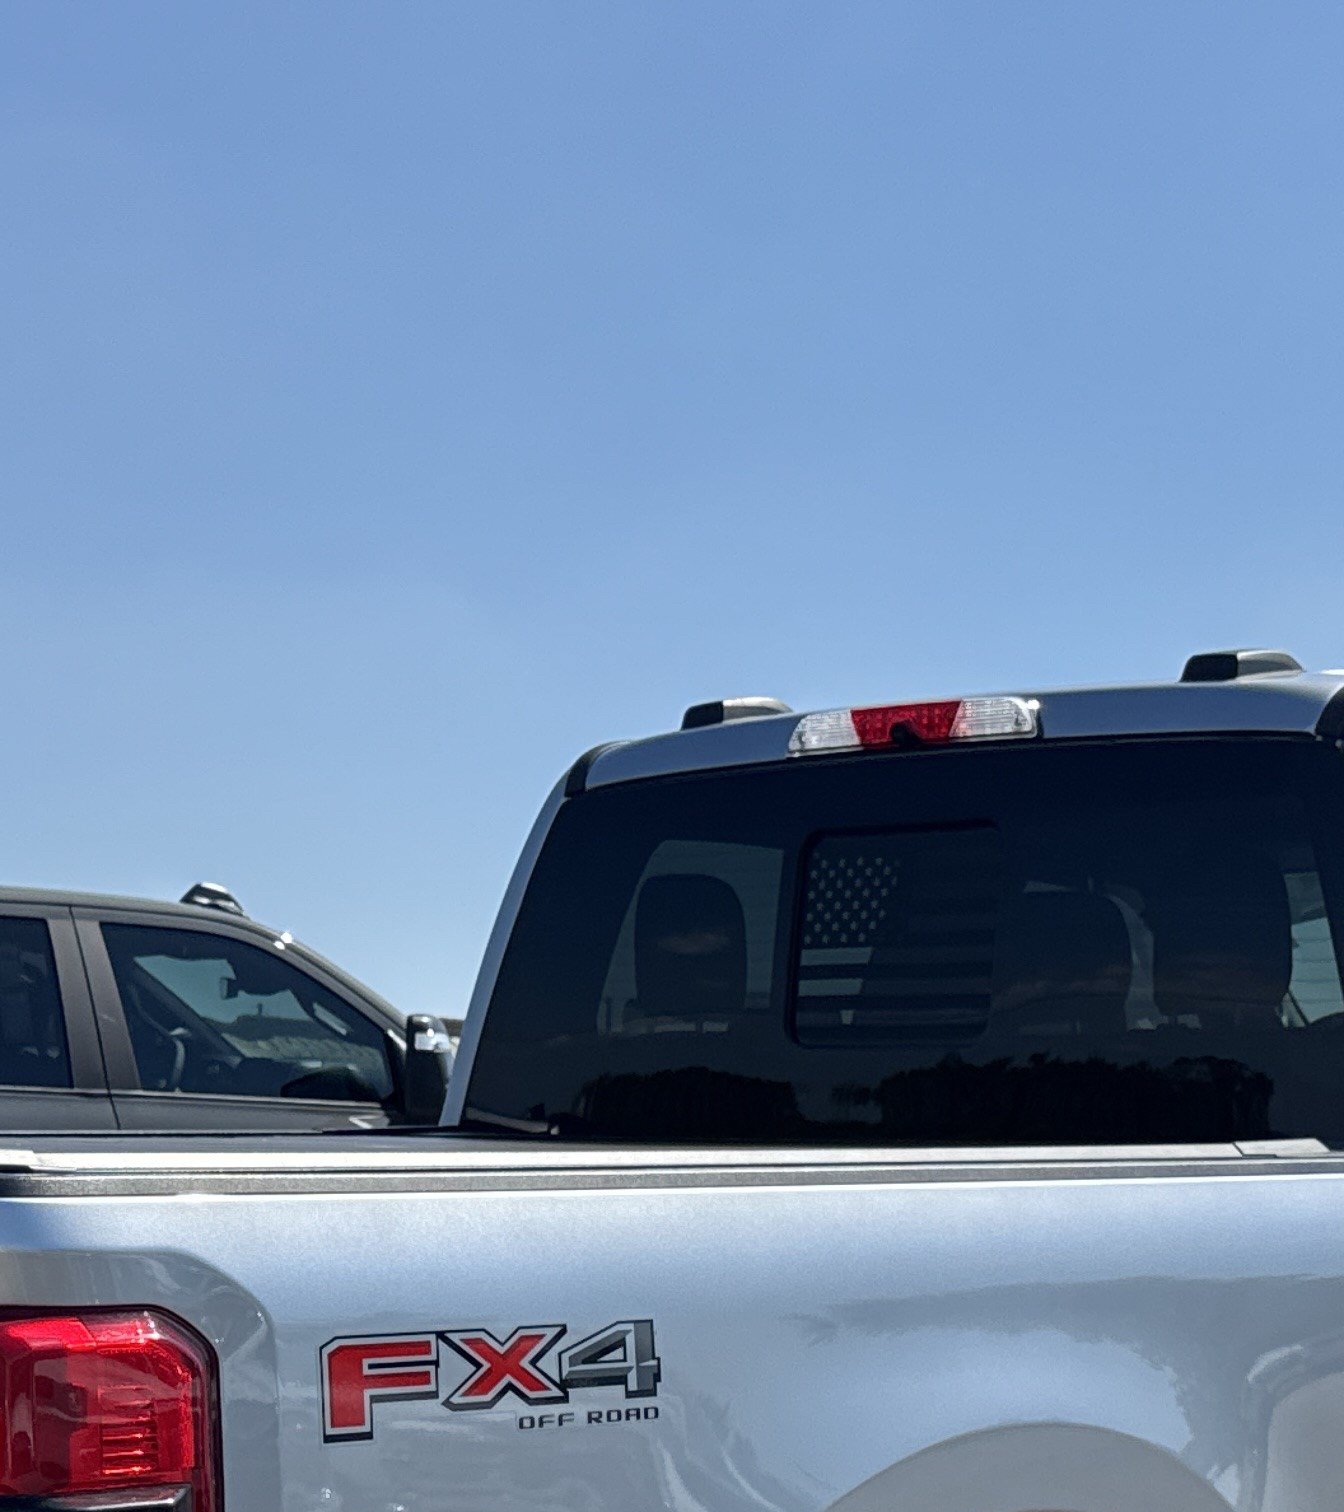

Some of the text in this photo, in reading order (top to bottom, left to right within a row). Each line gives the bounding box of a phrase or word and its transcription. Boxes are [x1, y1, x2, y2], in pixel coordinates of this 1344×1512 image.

[318, 1318, 662, 1444] FX4
[518, 1405, 660, 1431] OFF ROAD
